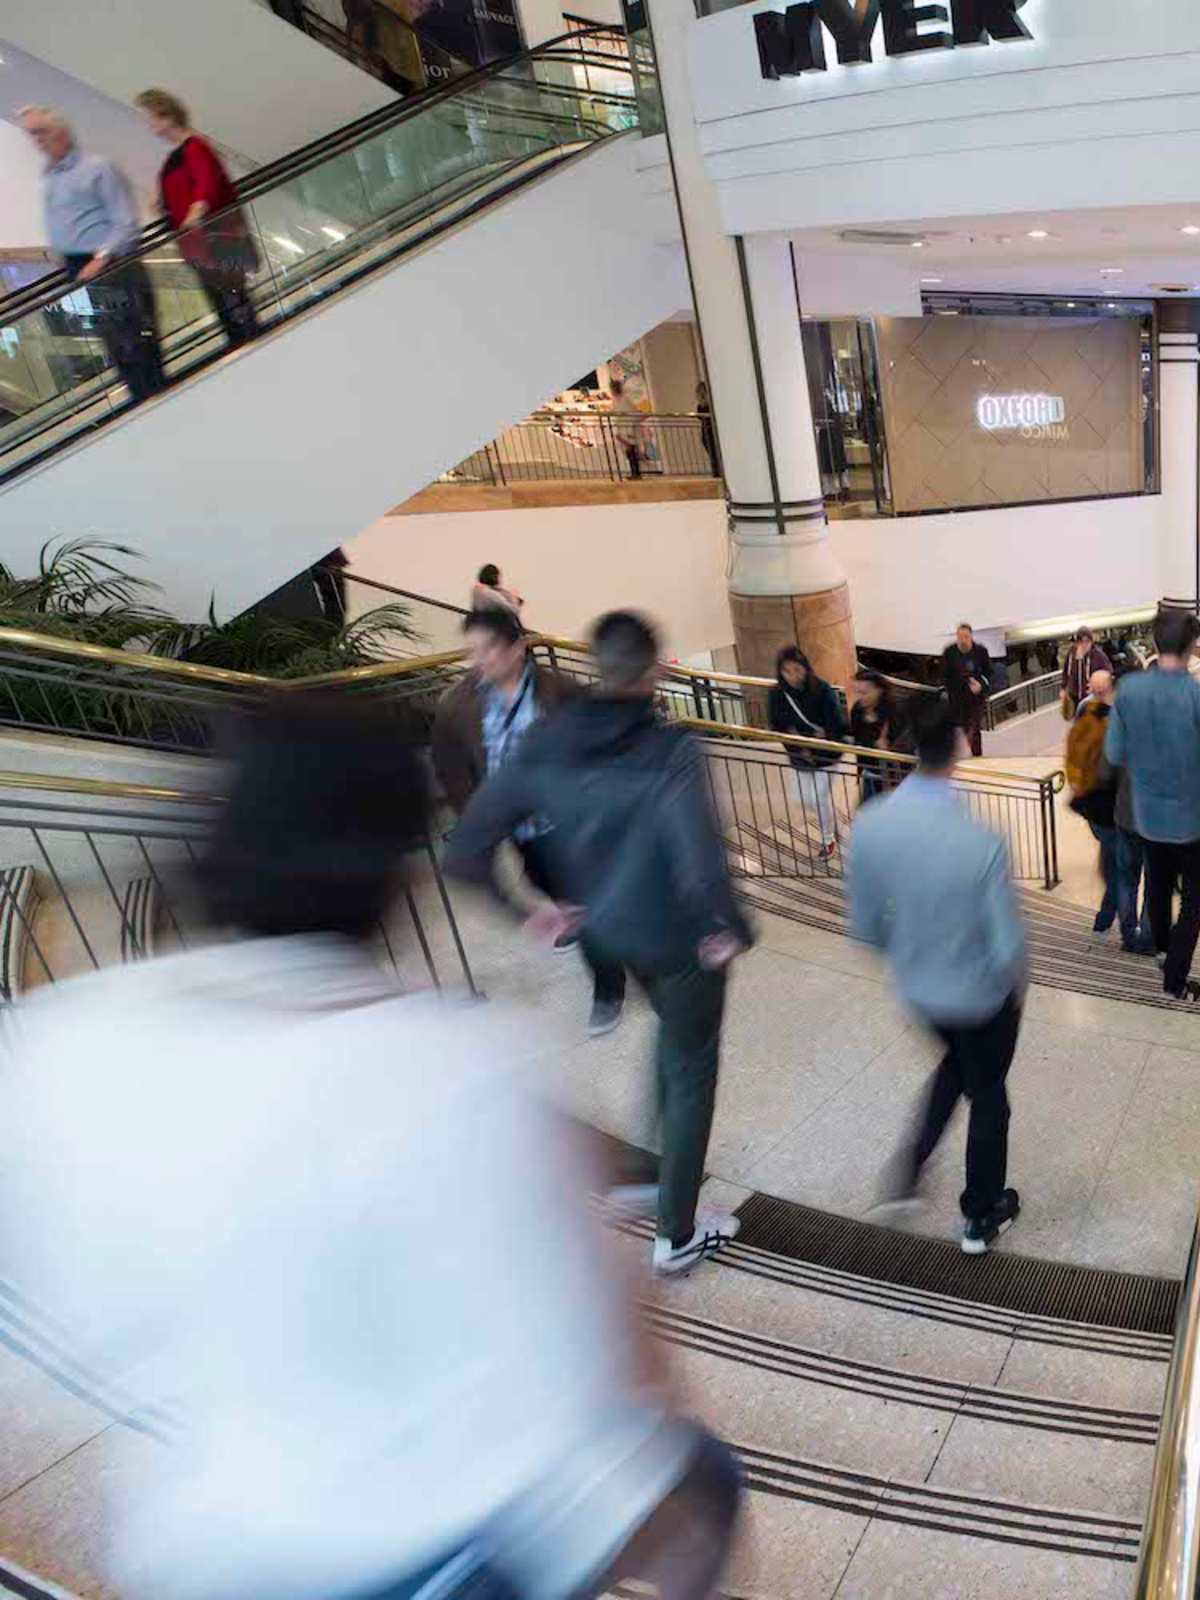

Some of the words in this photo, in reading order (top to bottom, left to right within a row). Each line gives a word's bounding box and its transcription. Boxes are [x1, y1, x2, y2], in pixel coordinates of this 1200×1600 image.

[752, 0, 1034, 80] MYER
[422, 56, 451, 79] ior
[979, 395, 1065, 429] OXFORD
